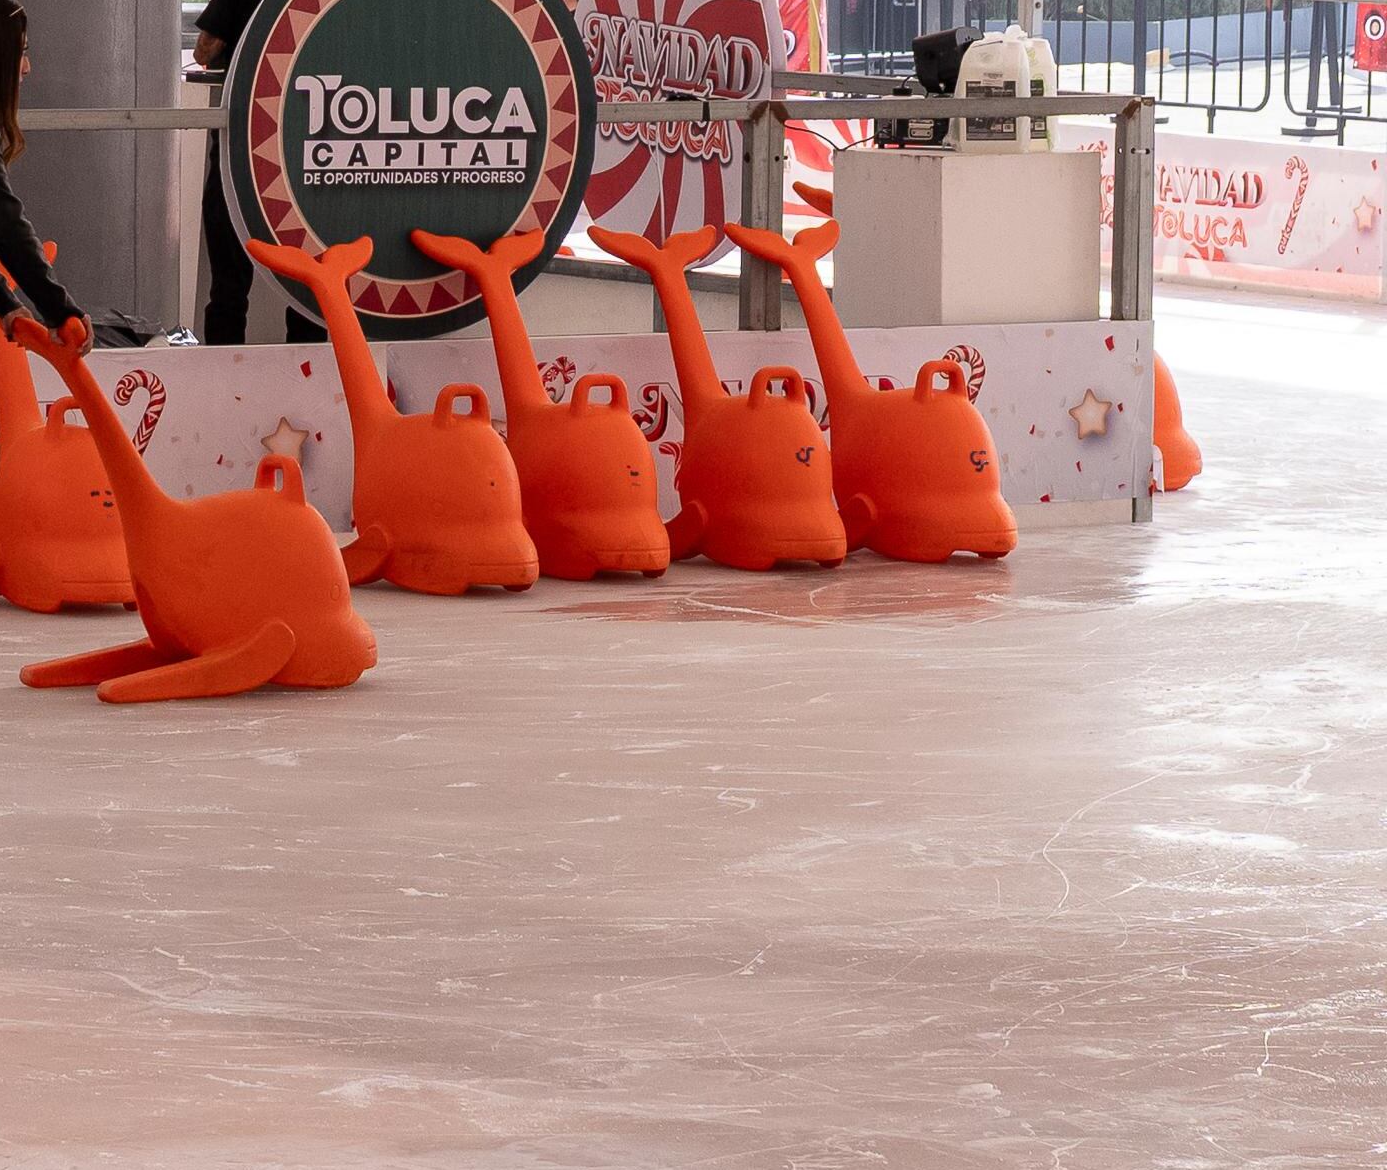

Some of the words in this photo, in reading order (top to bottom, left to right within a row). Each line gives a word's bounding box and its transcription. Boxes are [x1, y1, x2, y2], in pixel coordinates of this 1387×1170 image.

[583, 12, 763, 100] NAVIDAD
[294, 74, 538, 136] TOLUCA
[303, 172, 322, 185] DE
[323, 171, 439, 185] OPORTUNIDADES
[441, 171, 451, 184] Y
[453, 170, 526, 184] PROGRESO
[310, 141, 521, 169] CAPITAL
